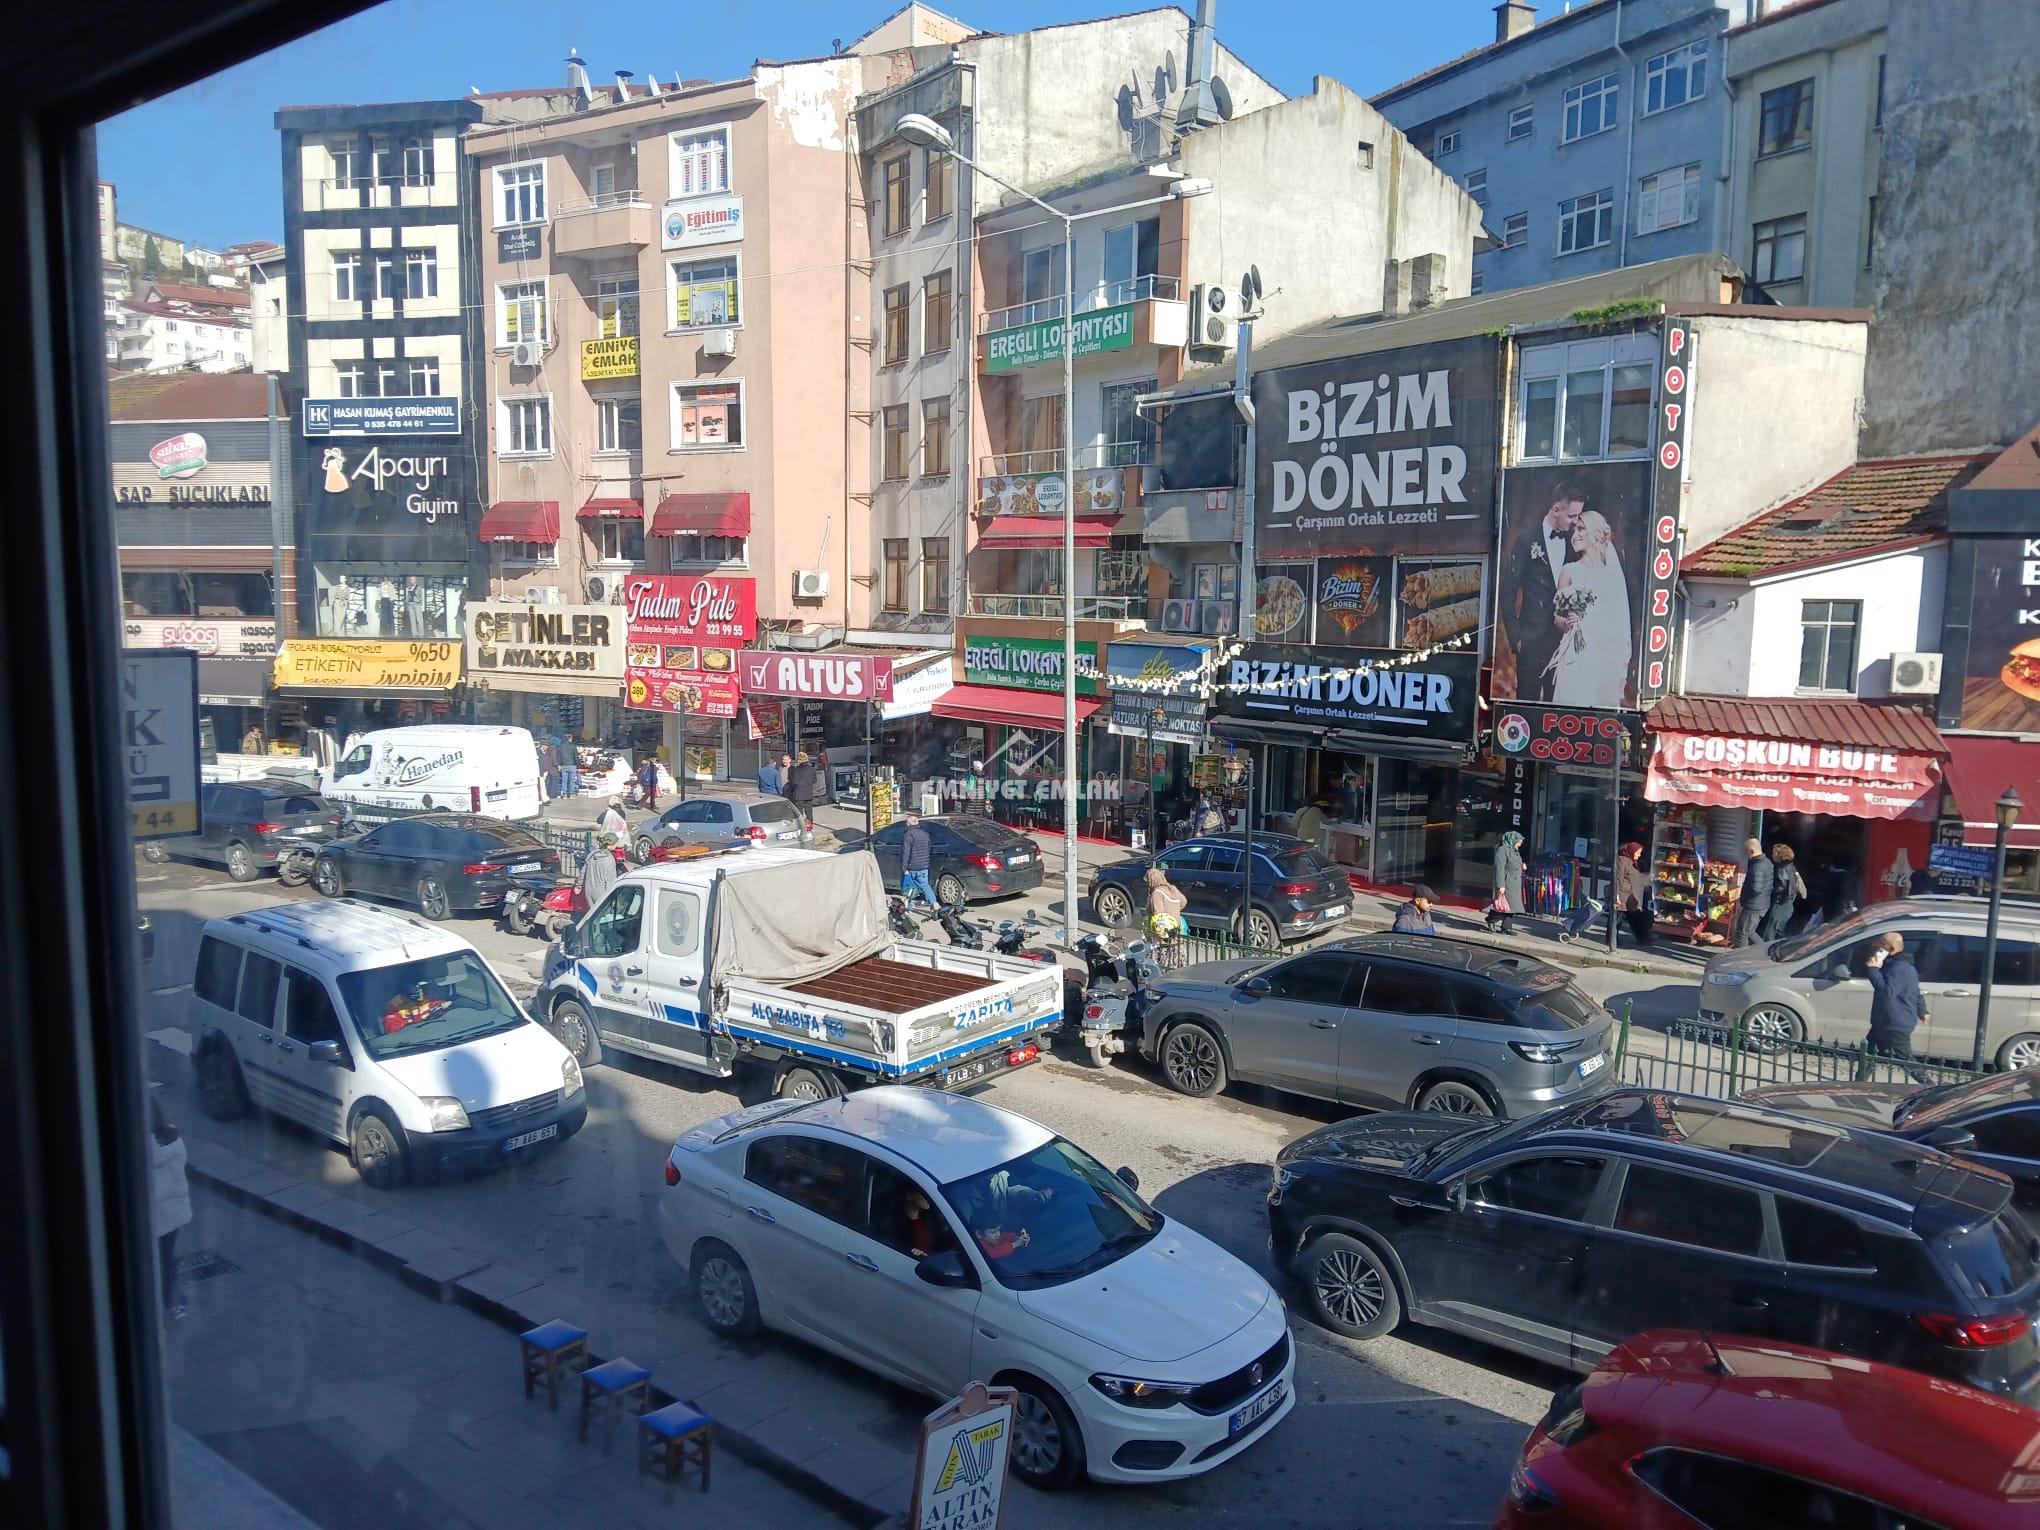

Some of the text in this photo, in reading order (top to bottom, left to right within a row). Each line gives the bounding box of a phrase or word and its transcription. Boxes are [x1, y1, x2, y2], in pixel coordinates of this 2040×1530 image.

[990, 326, 1037, 359] EREĞLİ
[592, 354, 637, 368] EMLAK
[334, 404, 455, 420] HASAN KUMAŞ GAYRİMENKUL
[1660, 328, 1685, 470] FOTO
[310, 408, 328, 421] HK
[414, 420, 424, 428] 61
[351, 447, 448, 490] Apayrı
[1272, 441, 1468, 514] DÖNER
[169, 485, 268, 502] SUCUKLARI
[406, 494, 459, 524] Giyim
[1295, 507, 1438, 532] Çarşının Ortak Lezzeti
[1320, 576, 1362, 603] Bizim
[1649, 515, 1675, 689] GÖZDE
[626, 580, 736, 626] Tadım Pide
[475, 606, 610, 648] ÇETİNLER
[706, 624, 720, 635] 323
[722, 625, 732, 635] 99
[733, 625, 743, 635] 55
[295, 655, 363, 673] ETİKETİN
[409, 642, 451, 663] %50
[502, 648, 596, 671] AYAKKABI
[965, 642, 1096, 677] EREĞLİ LOKANASI
[1142, 650, 1174, 676] ela
[375, 668, 453, 686] İNDİRİM
[777, 657, 863, 695] ALTUS
[1328, 658, 1455, 713] DÖNER
[805, 713, 821, 724] PİDE
[1112, 710, 1140, 726] FATURA
[1141, 712, 1168, 729] ÖEE
[1294, 704, 1378, 721] Çarşının Ortak Lezzeti
[1542, 714, 1622, 739] FOTO
[407, 750, 463, 779] Hanedan
[1683, 736, 1811, 768] COŞKUN
[752, 1002, 774, 1020] ALO
[776, 1007, 820, 1033] ZABITA
[1236, 1410, 1247, 1428] 67
[974, 1427, 1000, 1442] TARAK
[924, 1498, 997, 1530] RAK
[925, 1483, 993, 1525] ALTIN
